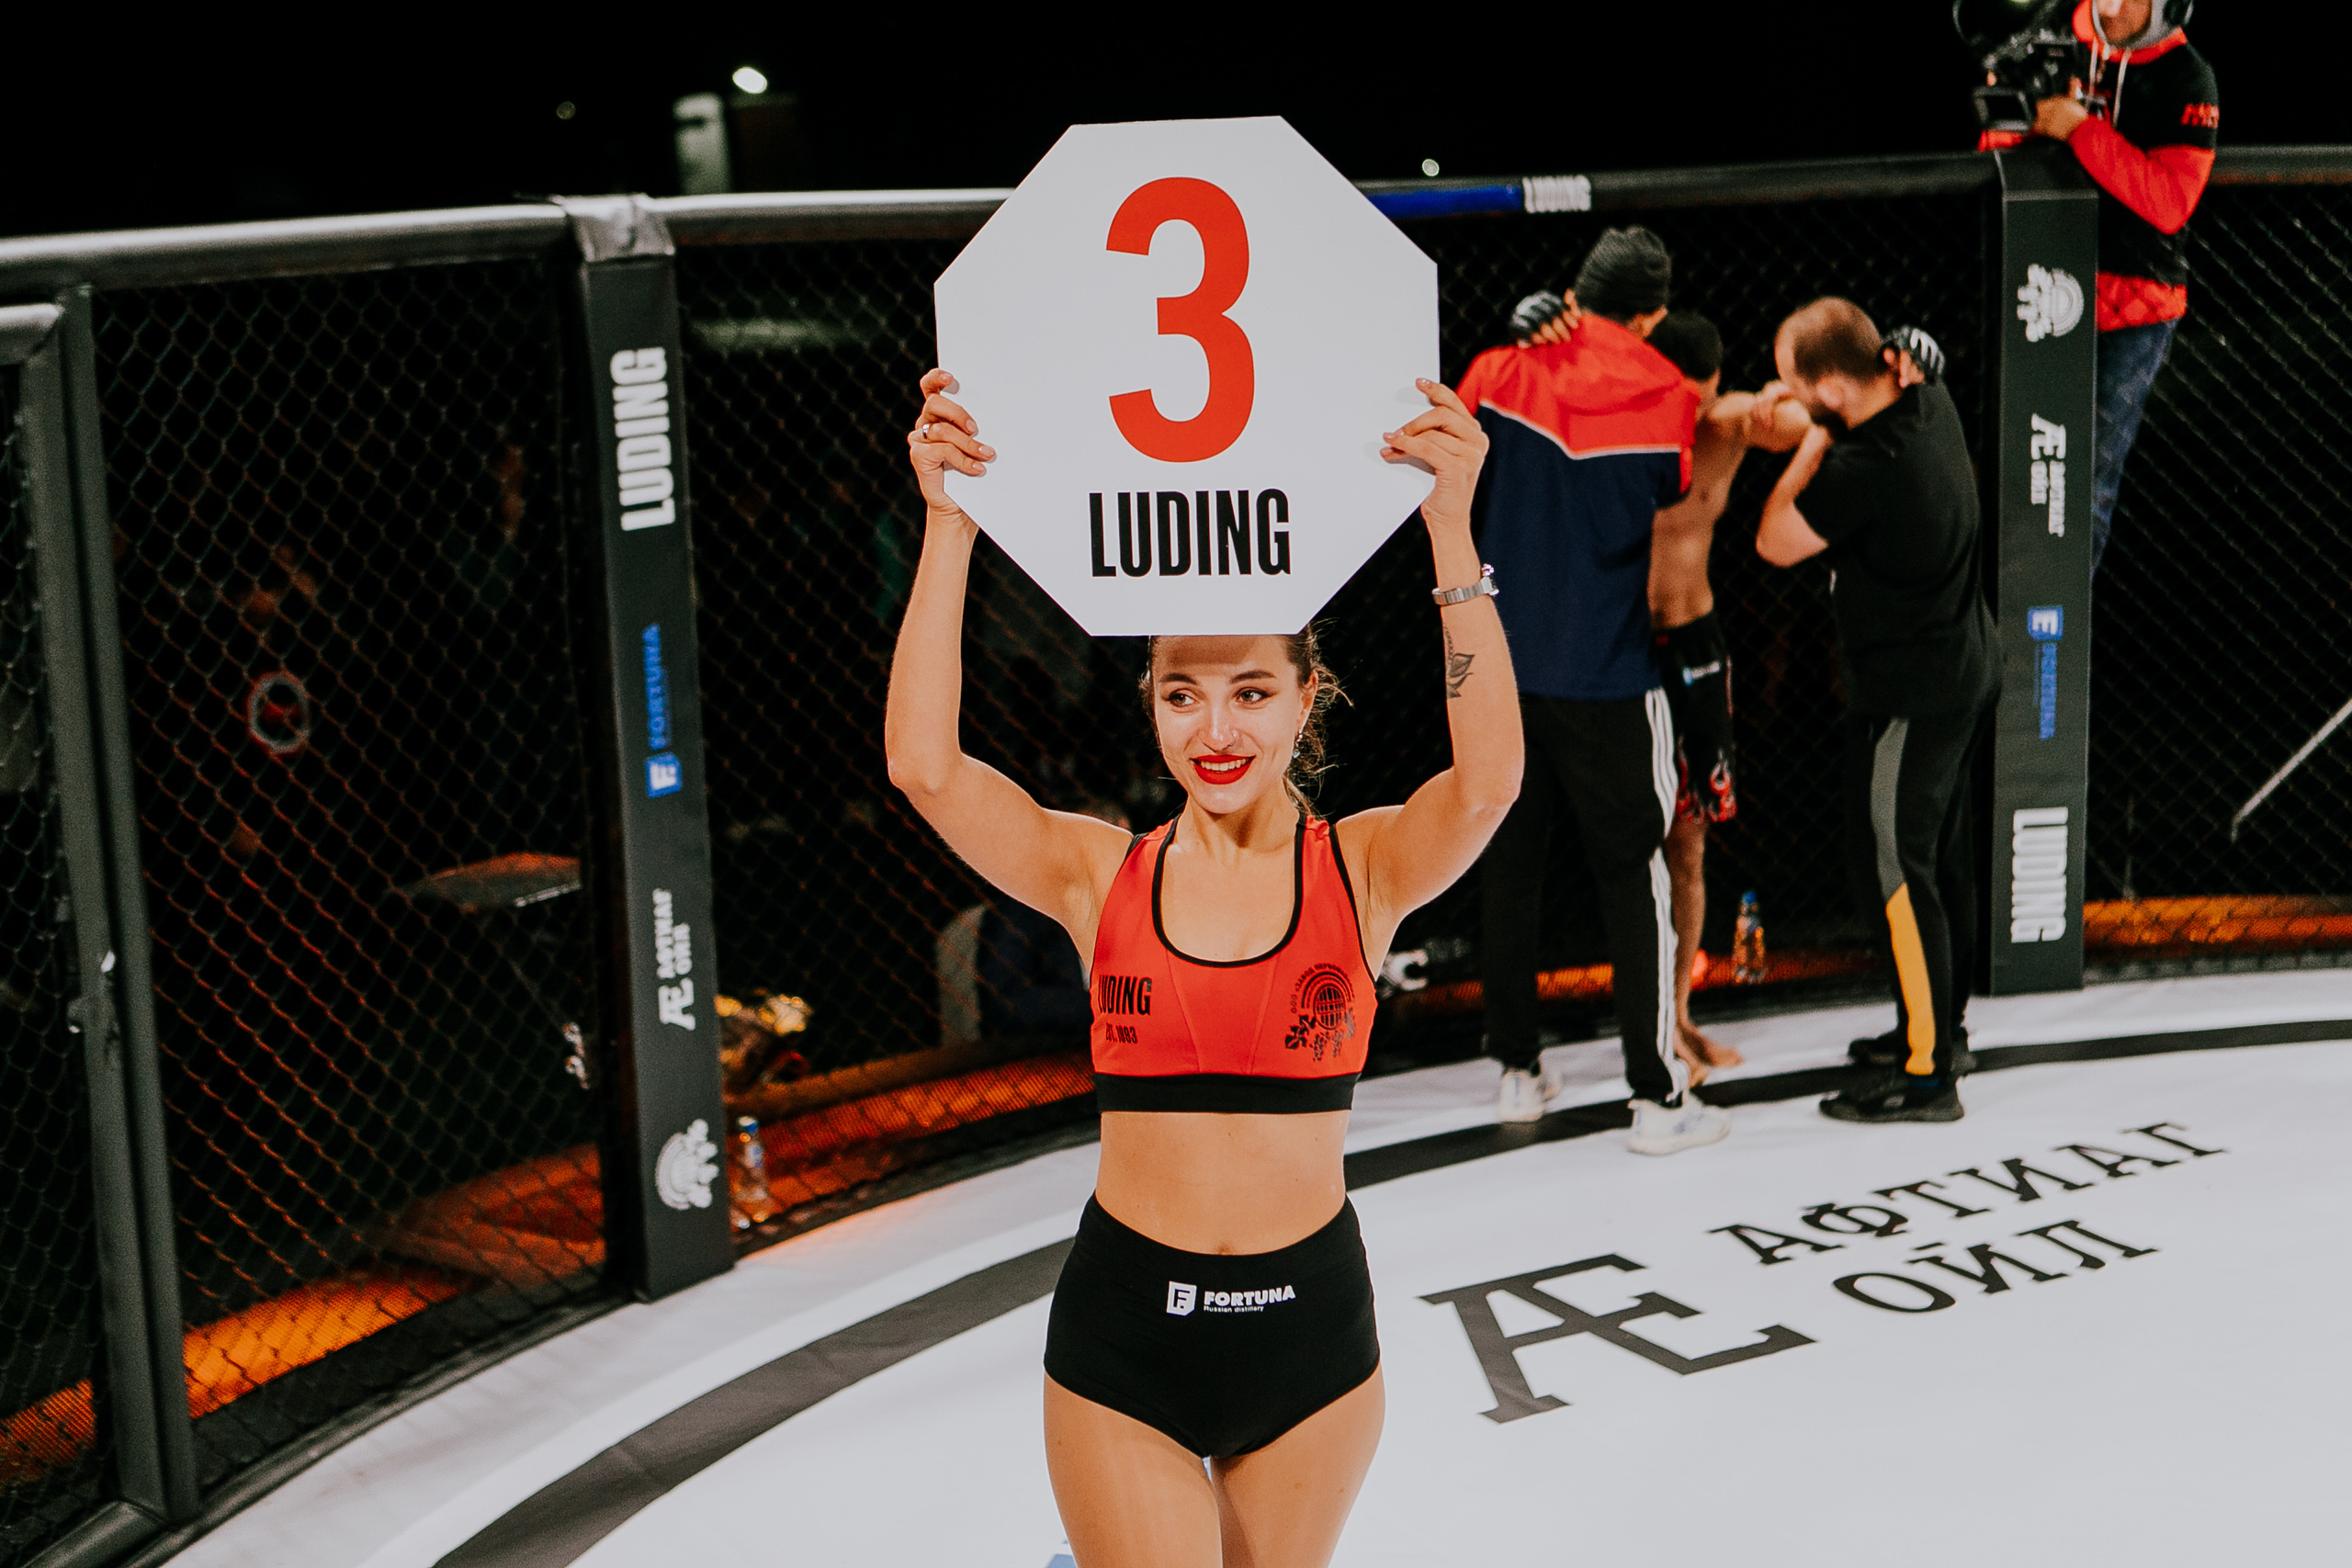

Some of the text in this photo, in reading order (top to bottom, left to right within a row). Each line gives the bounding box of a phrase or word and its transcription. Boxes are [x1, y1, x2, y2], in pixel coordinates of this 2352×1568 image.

[1105, 176, 1255, 464] 3
[610, 346, 676, 532] LUDING
[1089, 488, 1291, 578] LUDING
[2010, 807, 2069, 943] LUDING
[1706, 1122, 2230, 1266] АФТИАГ
[1204, 1284, 1296, 1307] FORTUNA
[1832, 1219, 2160, 1314] ОЙЛ
